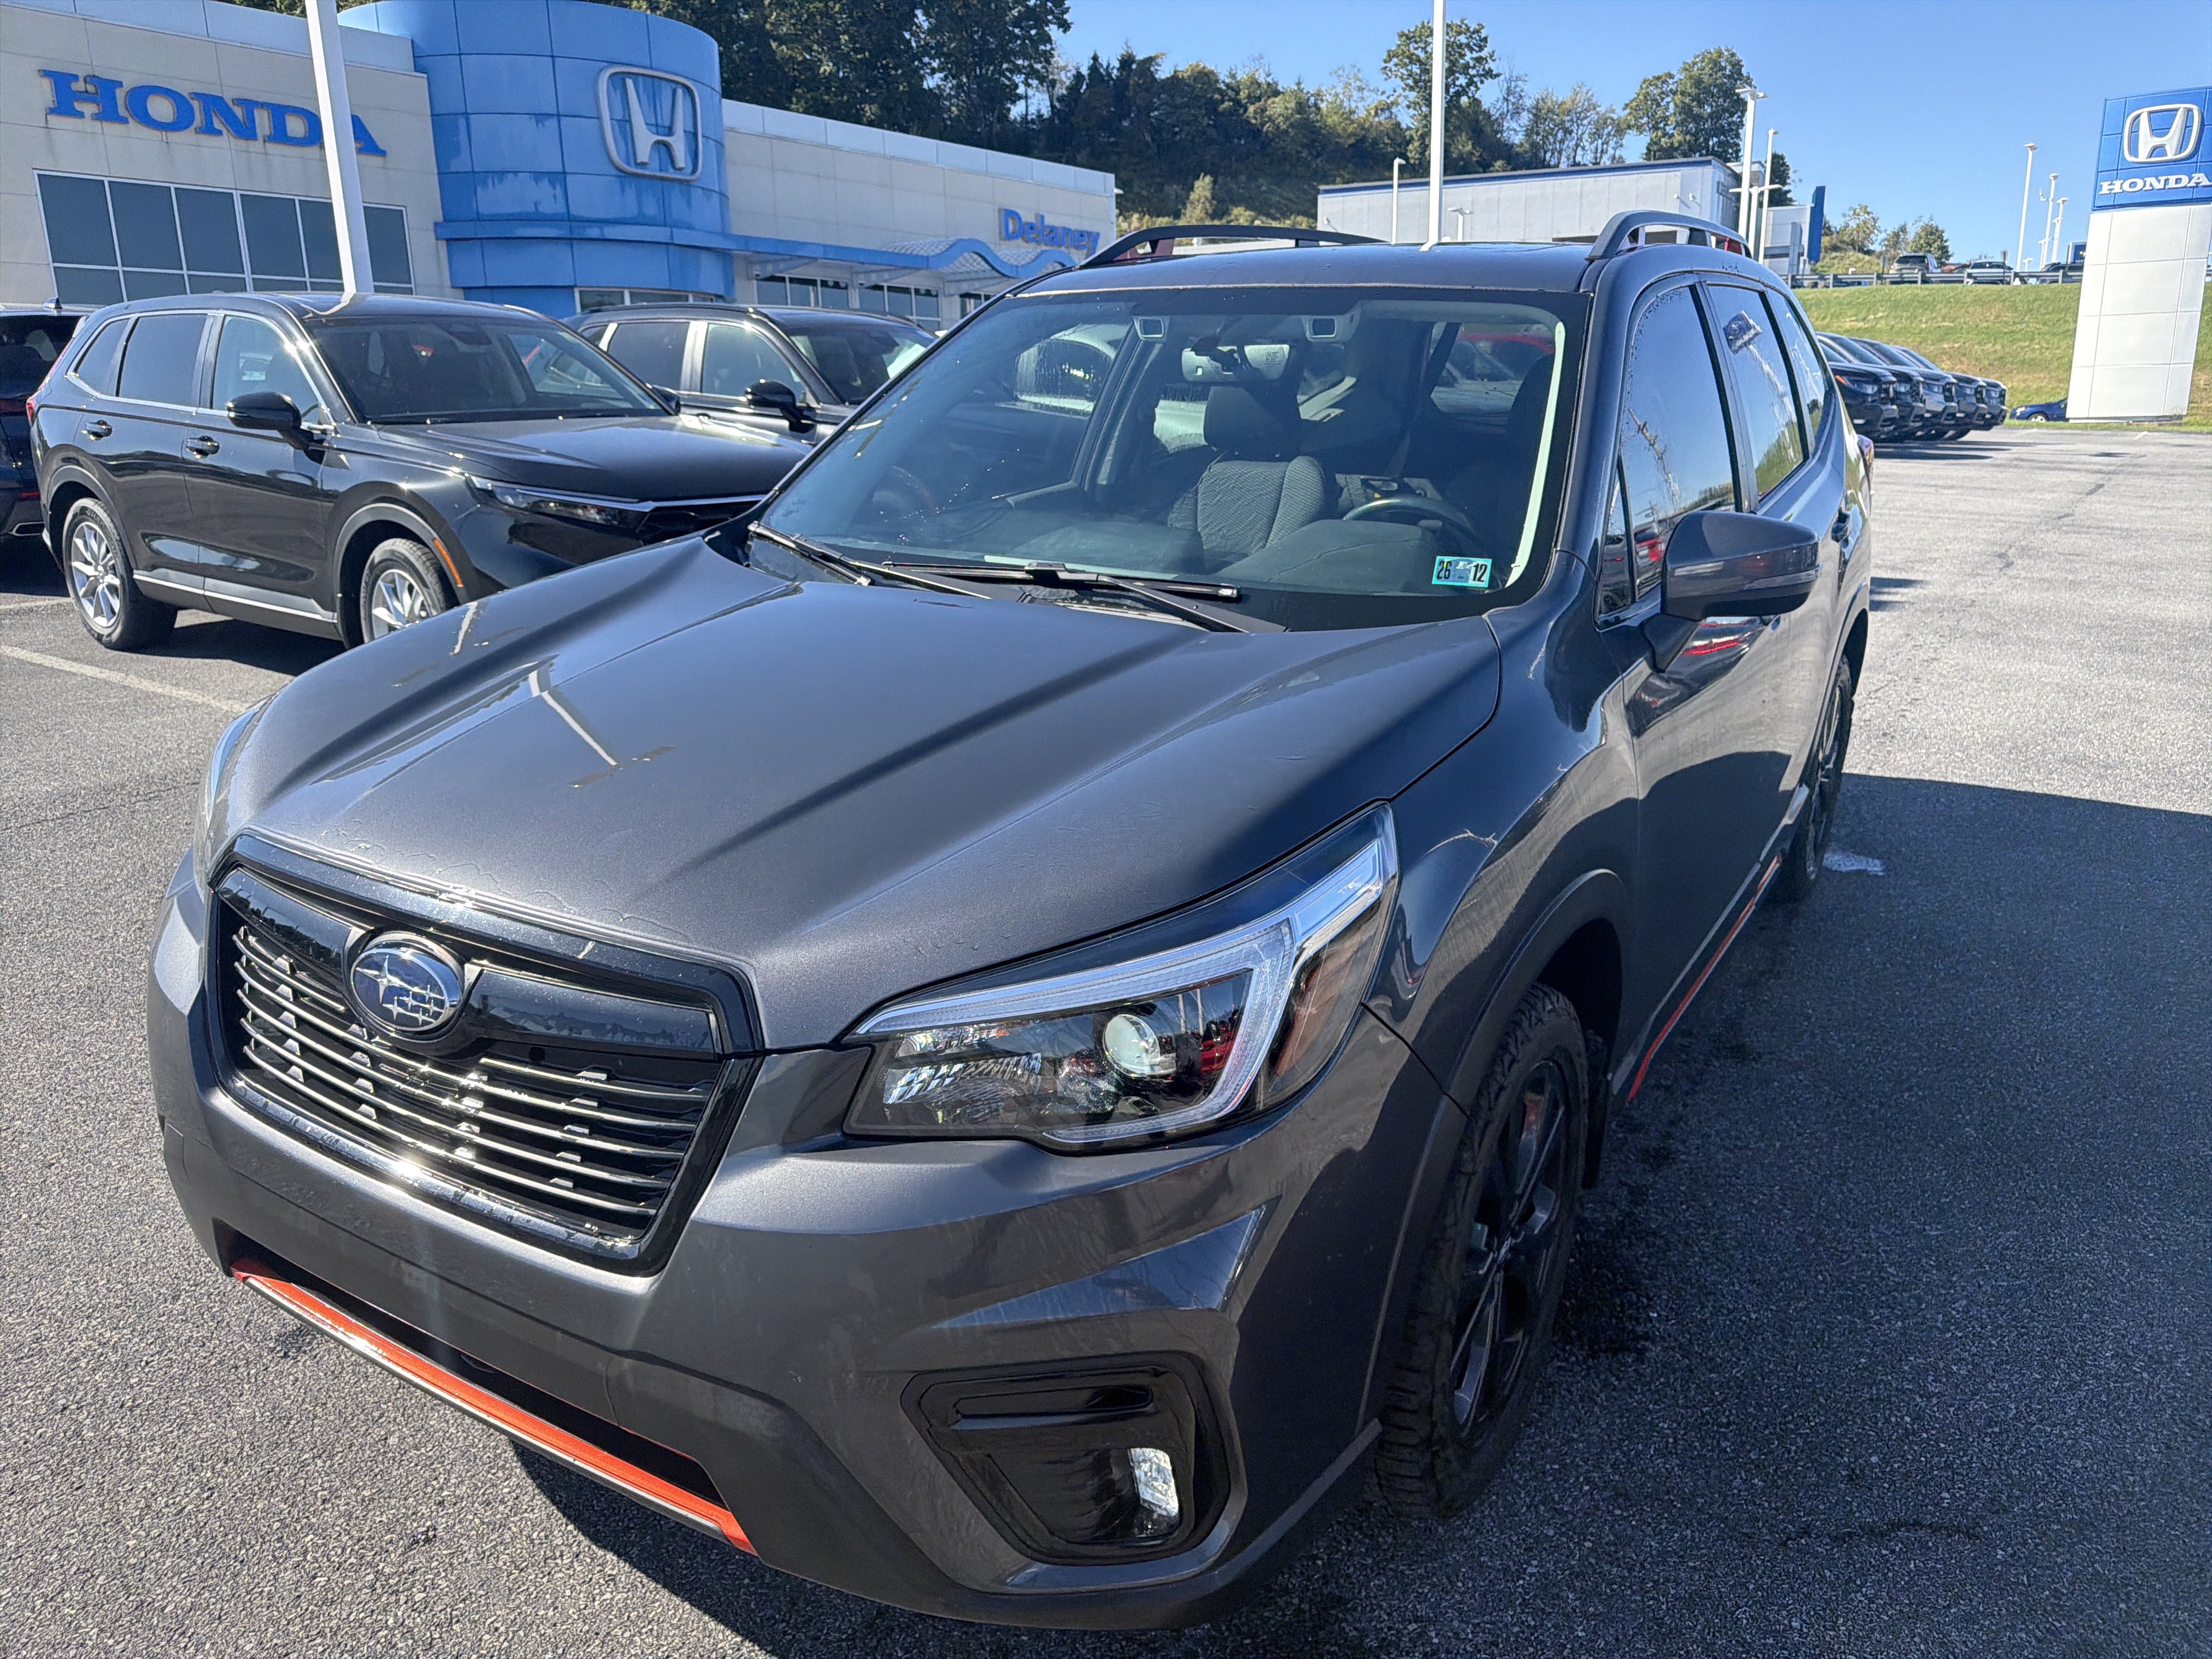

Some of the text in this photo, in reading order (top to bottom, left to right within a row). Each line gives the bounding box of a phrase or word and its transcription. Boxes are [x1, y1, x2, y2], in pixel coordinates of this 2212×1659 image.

[2099, 173, 2212, 195] HONDA
[1001, 208, 1101, 257] Delaney
[1436, 560, 1488, 583] 26 12
